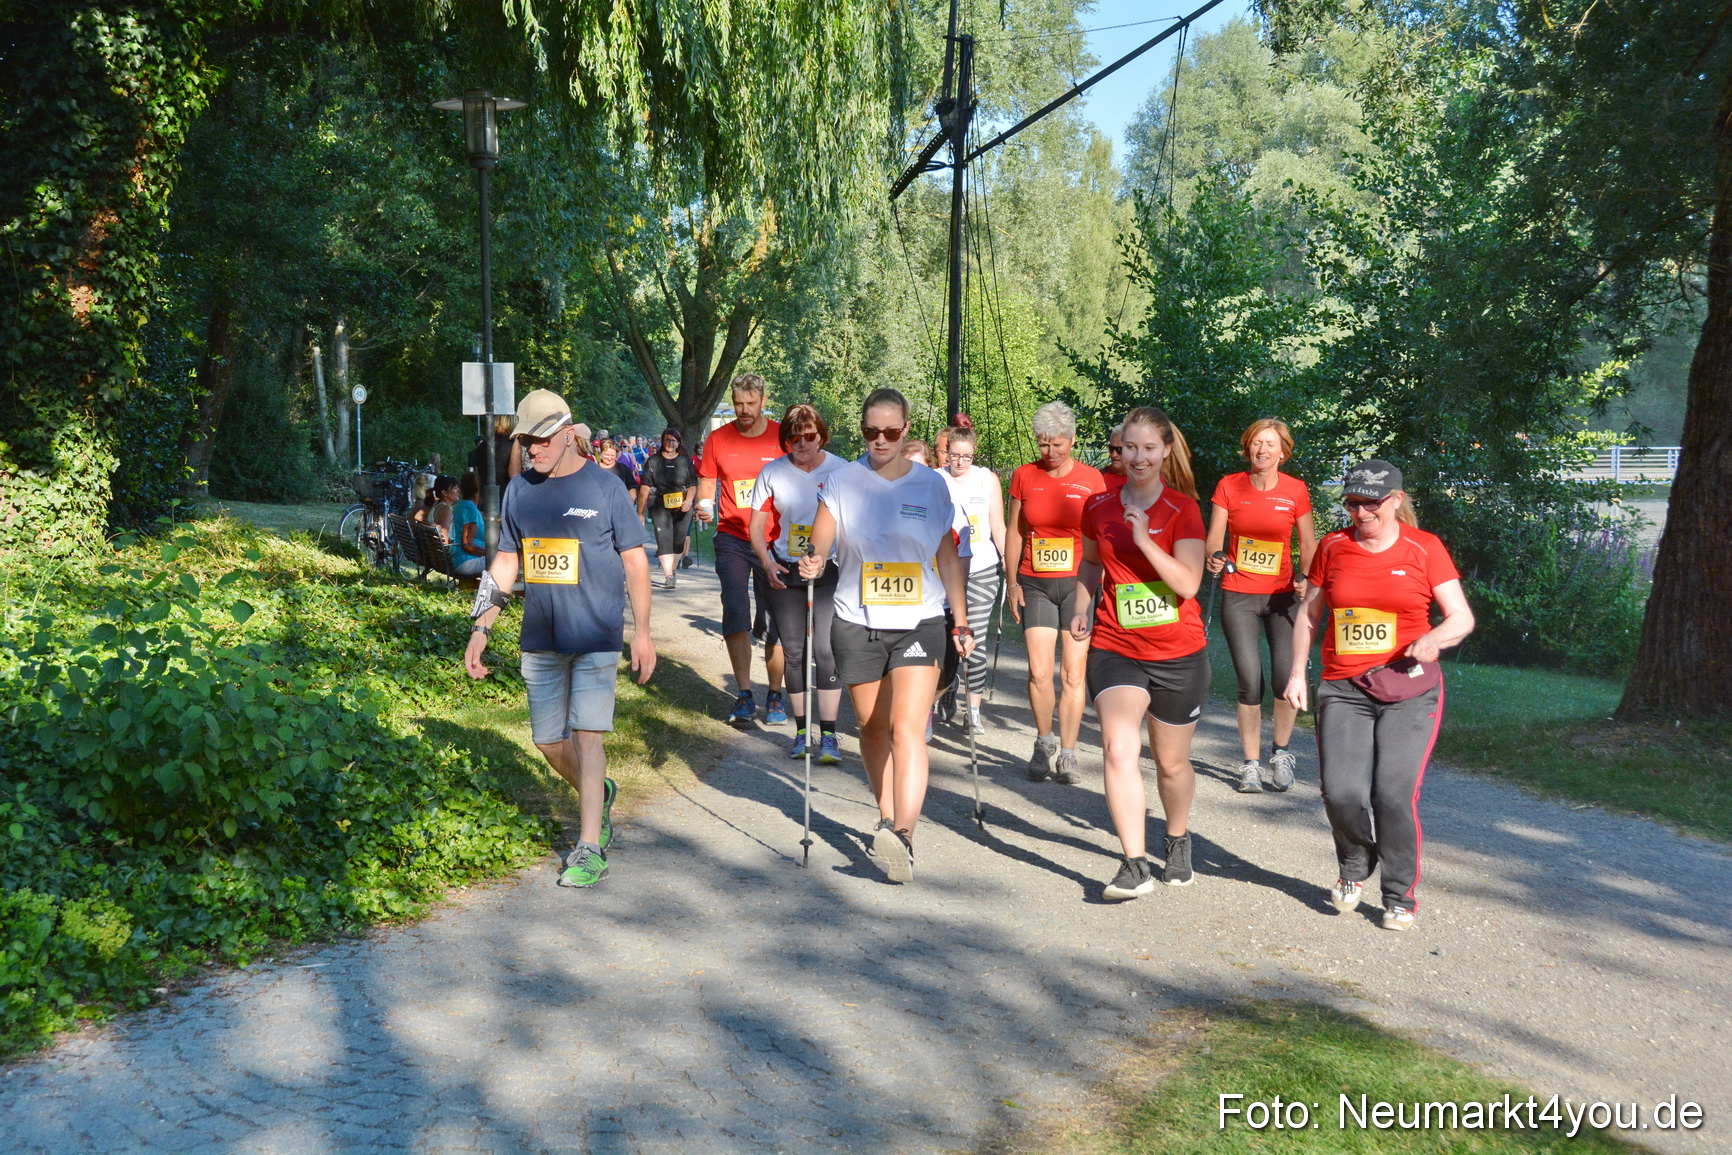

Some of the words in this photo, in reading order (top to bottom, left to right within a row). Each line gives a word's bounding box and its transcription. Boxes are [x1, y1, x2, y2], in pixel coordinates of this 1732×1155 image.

[530, 554, 569, 571] 1093
[1036, 549, 1068, 562] 1500
[1242, 549, 1276, 566] 1497
[870, 577, 914, 593] 1410
[1124, 595, 1169, 616] 1504
[1342, 623, 1387, 641] 1506
